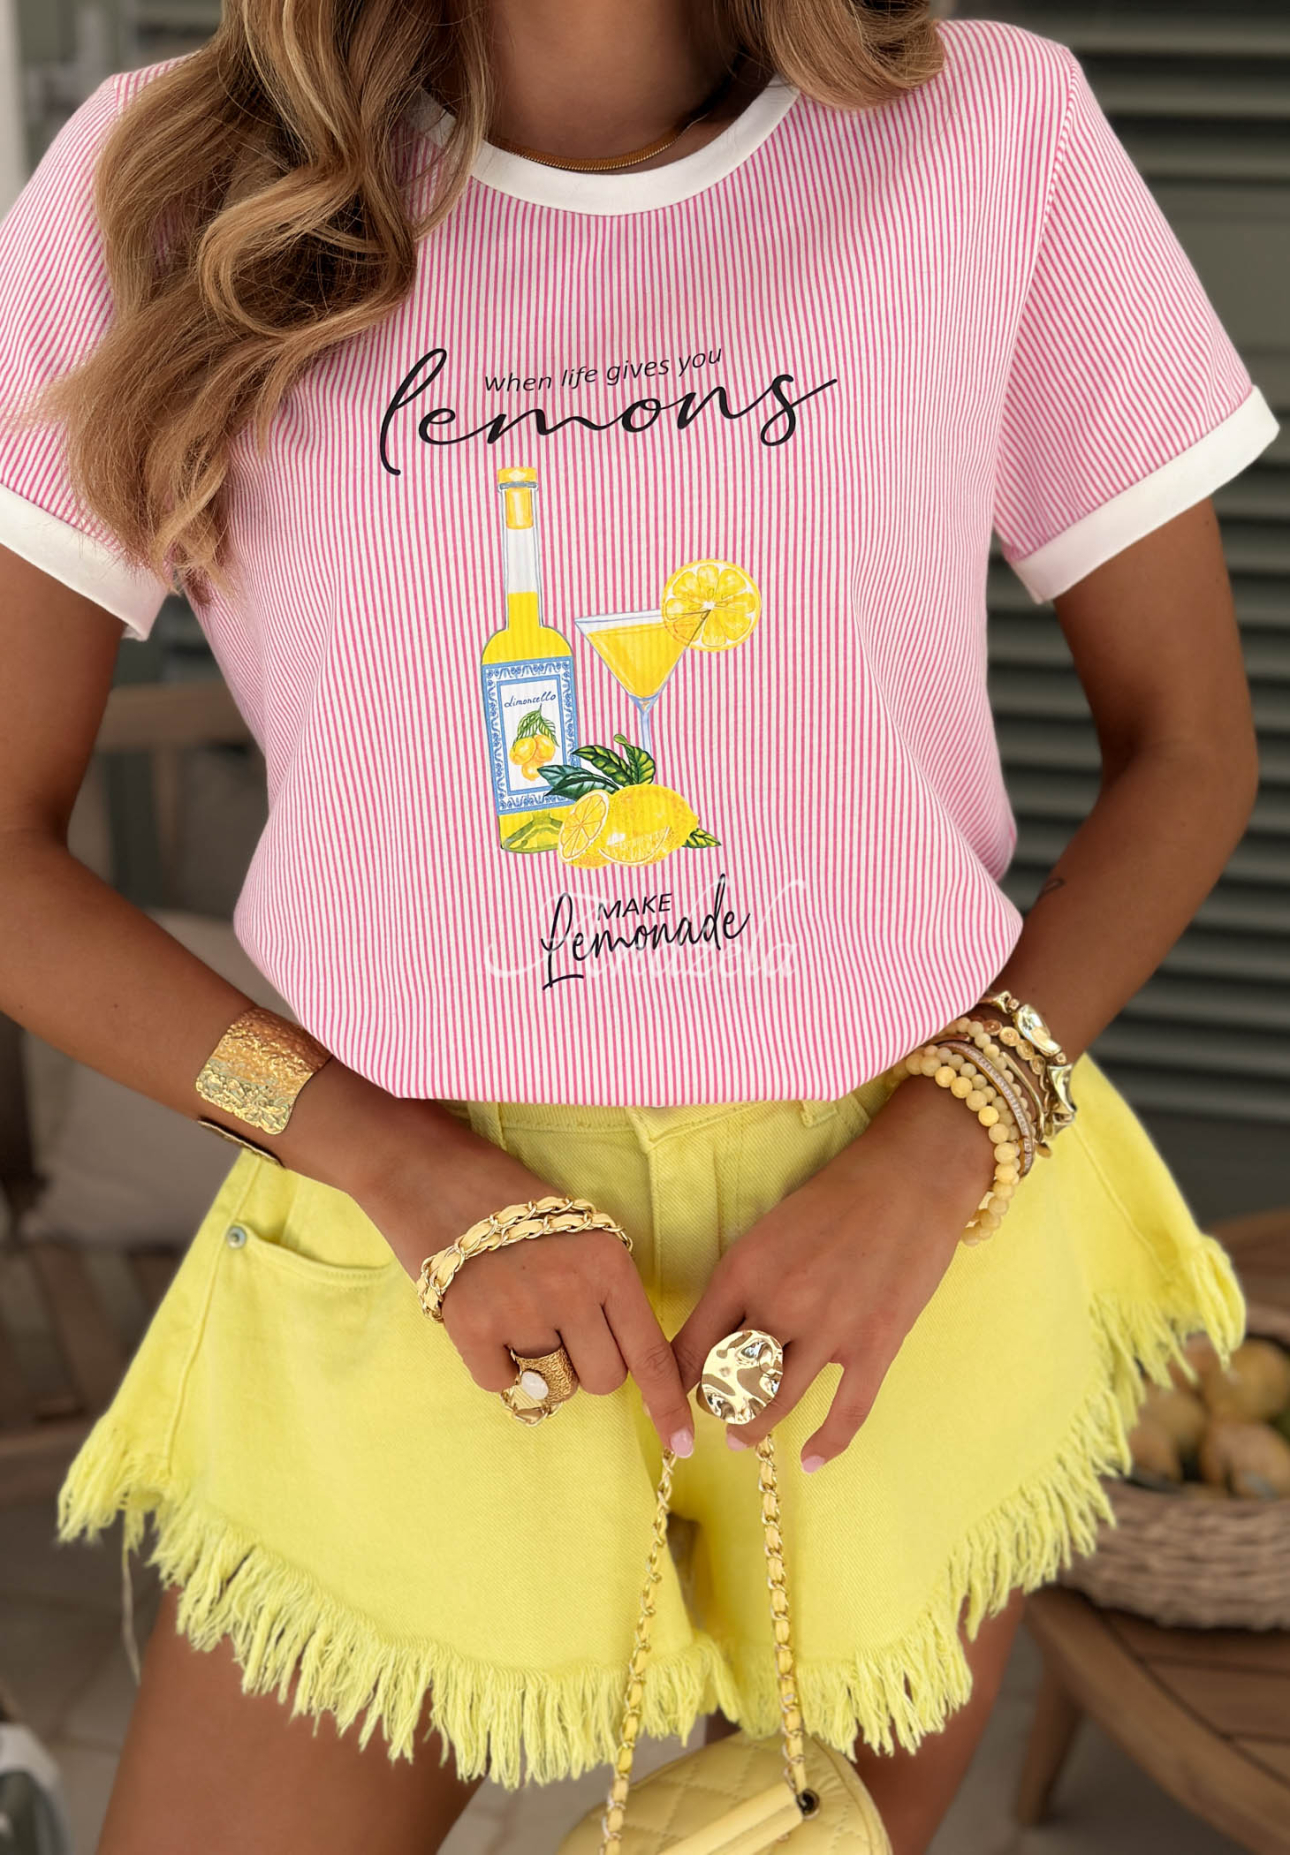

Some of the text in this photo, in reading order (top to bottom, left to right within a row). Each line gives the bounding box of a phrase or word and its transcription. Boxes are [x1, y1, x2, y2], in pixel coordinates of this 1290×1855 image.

[560, 363, 598, 388] life
[606, 359, 670, 386] gives
[678, 347, 723, 377] you
[379, 347, 838, 476] lemons
[540, 872, 751, 991] Lemonade
[597, 892, 673, 921] MAKE
